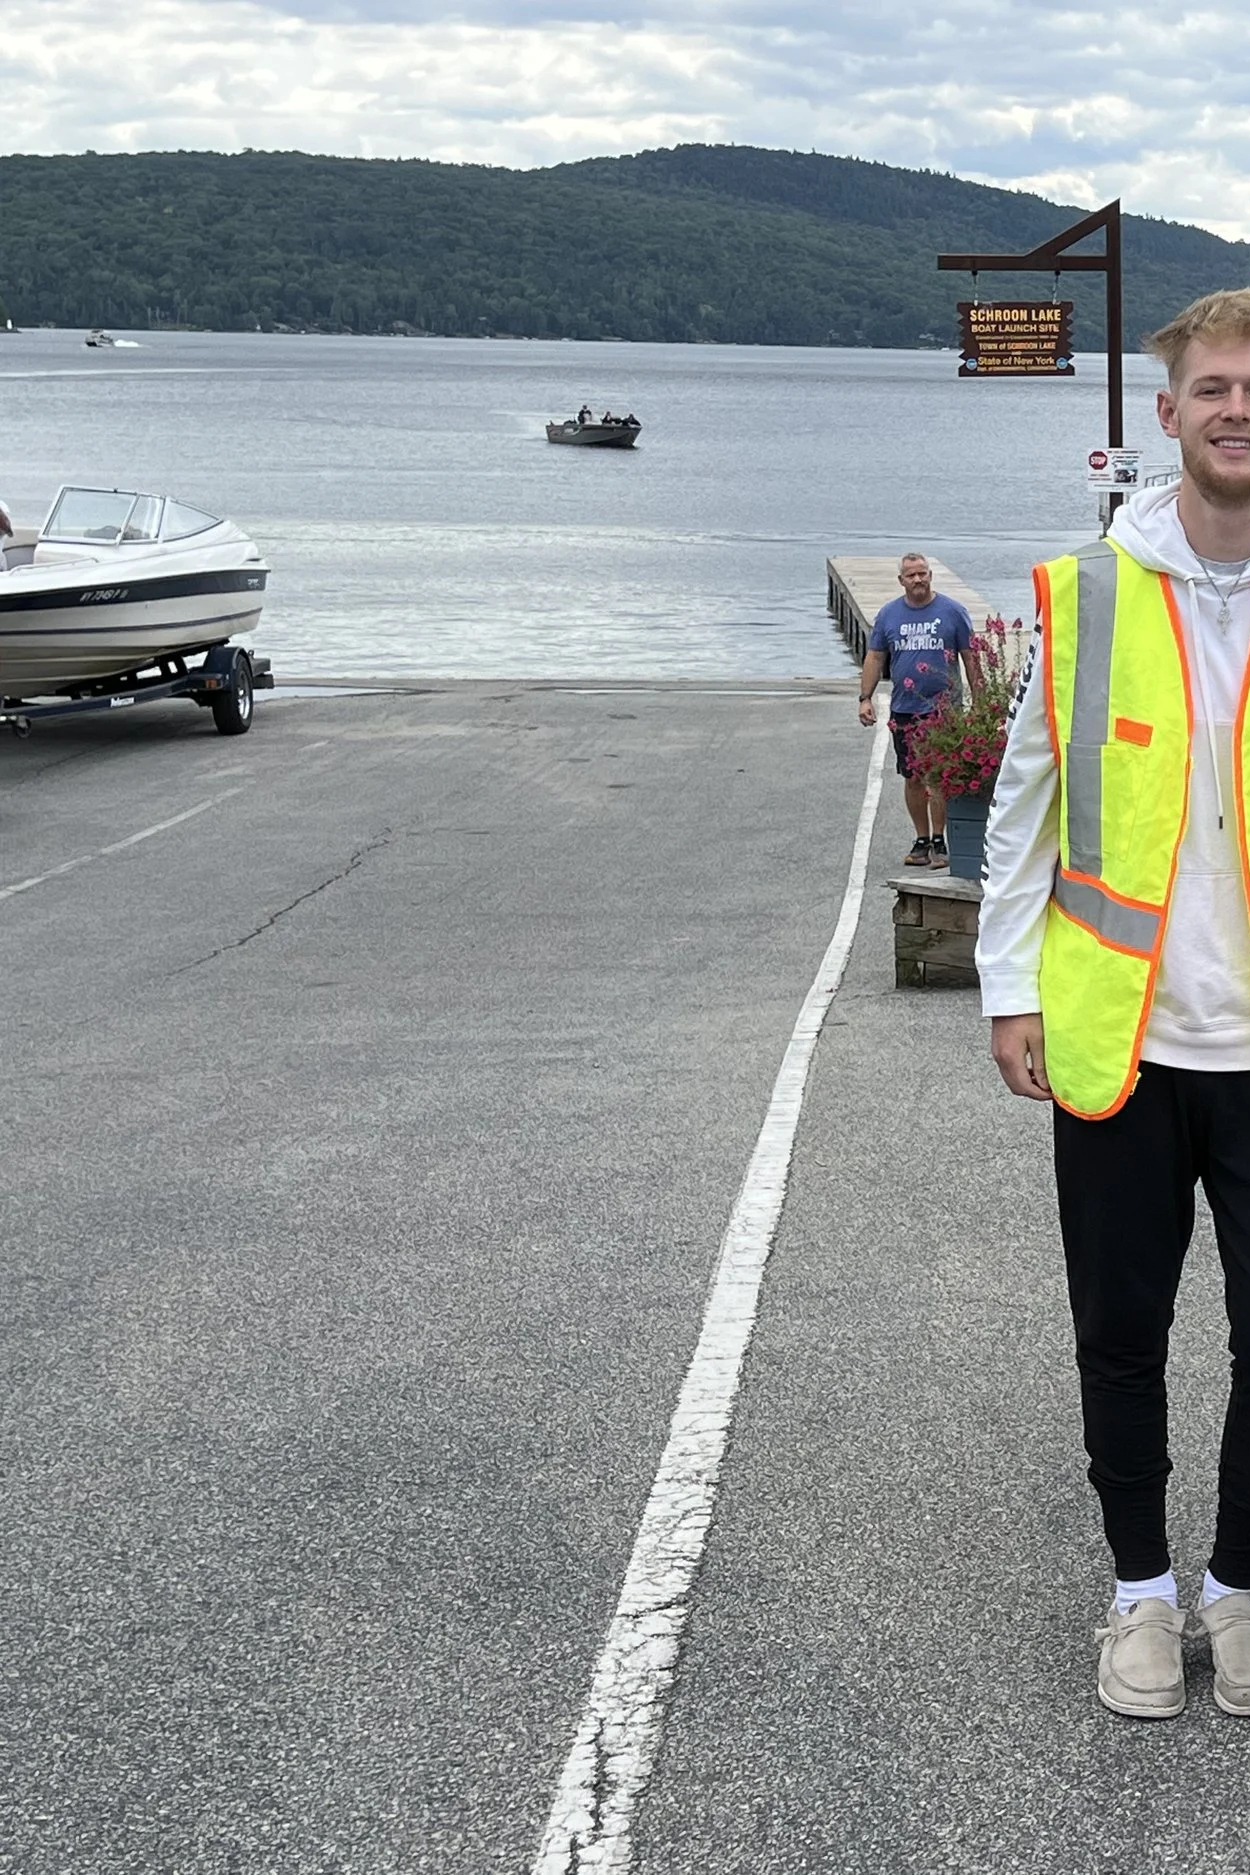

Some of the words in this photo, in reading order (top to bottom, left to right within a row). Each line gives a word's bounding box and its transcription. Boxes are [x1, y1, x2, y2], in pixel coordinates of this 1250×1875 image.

[970, 309, 1027, 321] SCHROON
[1032, 309, 1061, 321] LAKE
[971, 324, 996, 333] BOAT
[998, 324, 1037, 333] LAUNCH
[1039, 324, 1059, 332] SITE
[979, 342, 998, 350] TOWN
[999, 342, 1006, 350] of
[1039, 342, 1056, 350] LAKE
[978, 356, 1001, 366] State
[1002, 356, 1012, 365] of
[1014, 356, 1034, 365] New
[1035, 356, 1055, 365] York
[900, 621, 938, 636] SHAPE
[894, 637, 945, 651] AMERICA
